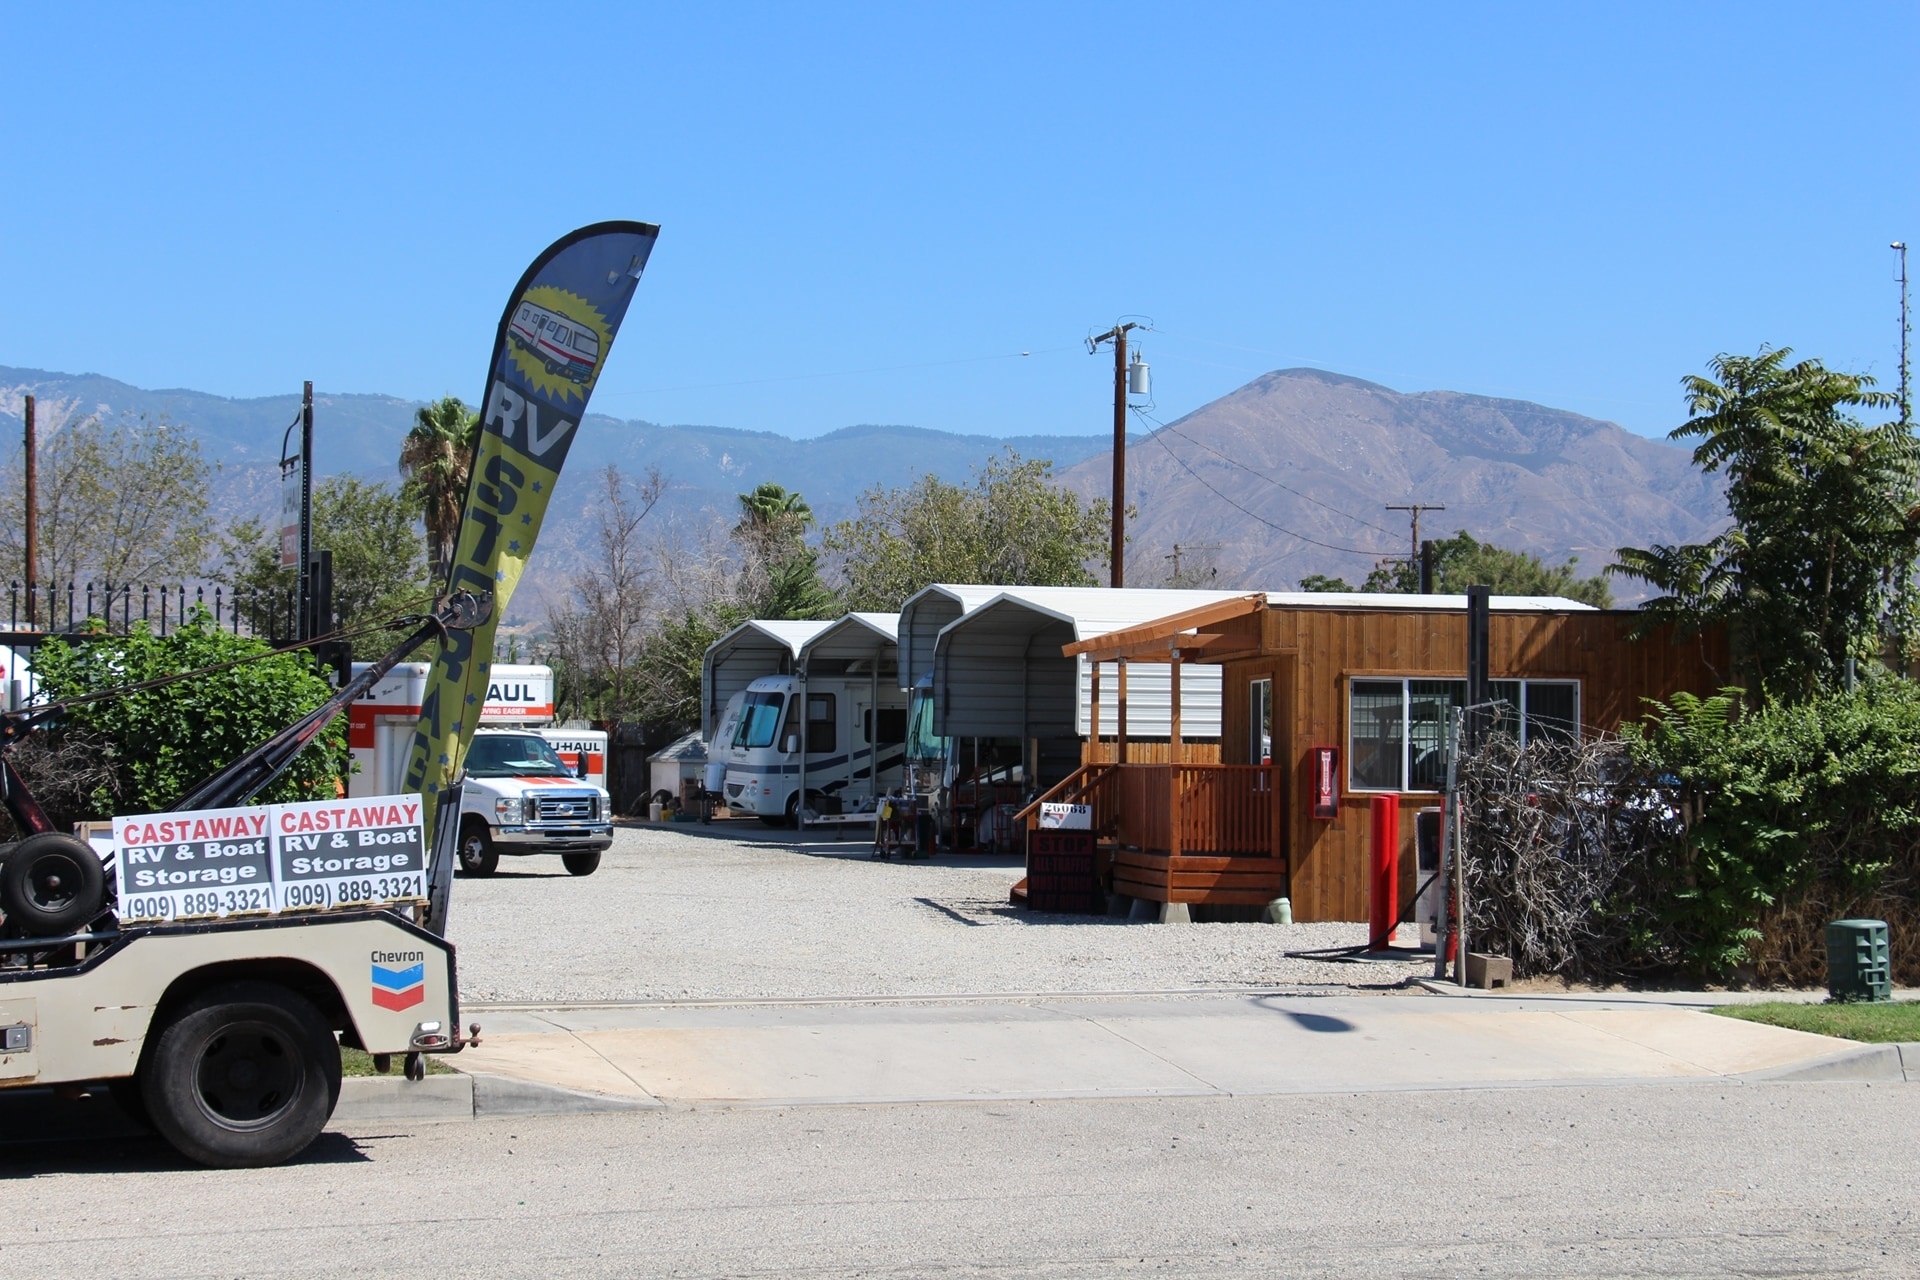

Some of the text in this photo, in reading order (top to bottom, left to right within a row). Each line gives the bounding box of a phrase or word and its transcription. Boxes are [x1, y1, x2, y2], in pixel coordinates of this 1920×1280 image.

[485, 380, 573, 456] RV
[486, 684, 535, 701] AUL
[549, 742, 600, 752] U-HAUL
[280, 804, 418, 833] CASTAWAY
[1044, 803, 1087, 815] 26068
[124, 815, 265, 845] CASTAWAY
[285, 828, 417, 852] RV & Boat
[128, 839, 265, 864] RV & Boat
[1039, 837, 1088, 852] STOP
[292, 853, 409, 874] Storage
[135, 865, 257, 887] Storage
[284, 875, 421, 908] (909) 889-3321
[127, 888, 271, 921] (909) 889-3321
[371, 950, 424, 963] Chevron
